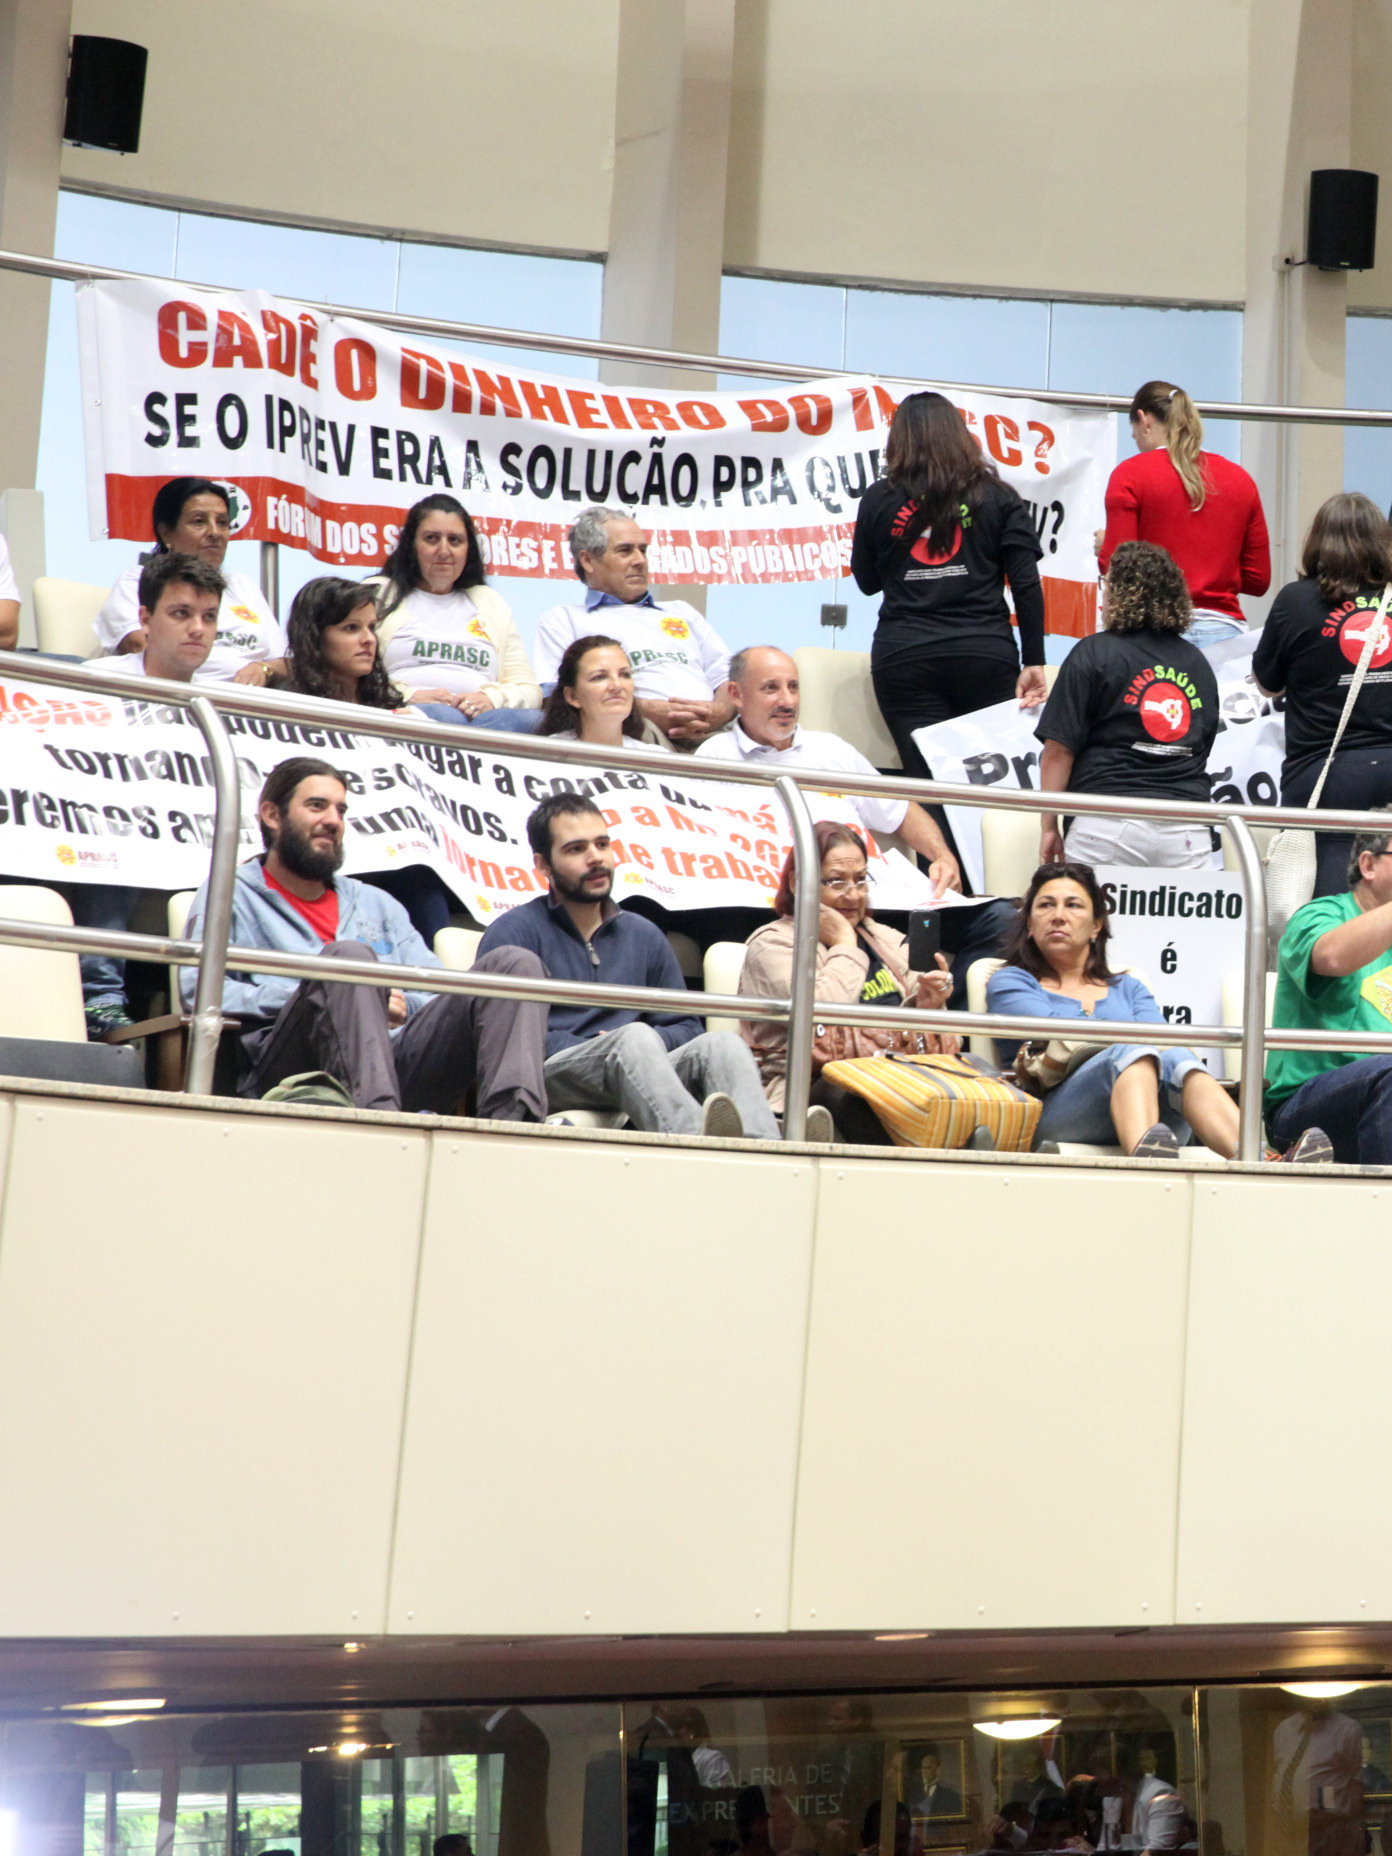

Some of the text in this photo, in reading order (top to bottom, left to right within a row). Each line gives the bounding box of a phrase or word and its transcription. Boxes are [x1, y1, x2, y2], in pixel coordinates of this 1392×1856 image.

[157, 299, 320, 392] CADÊ
[334, 337, 378, 402] O
[400, 346, 729, 432] DINHEIRO
[736, 393, 834, 437] DO
[143, 390, 201, 450] SE
[215, 392, 249, 451] O
[264, 393, 357, 477] IPREV
[370, 424, 455, 489] ERA
[462, 438, 489, 492] A
[712, 454, 798, 508] PRA
[265, 495, 323, 550] FÓRUM
[325, 520, 380, 557] DOS
[732, 537, 855, 576] PÚBLICOS
[412, 639, 491, 668] APRASC
[1123, 664, 1204, 712] SINDSAÚDE
[492, 763, 518, 798] a
[1101, 882, 1244, 920] Sindicato
[1159, 941, 1178, 975] é
